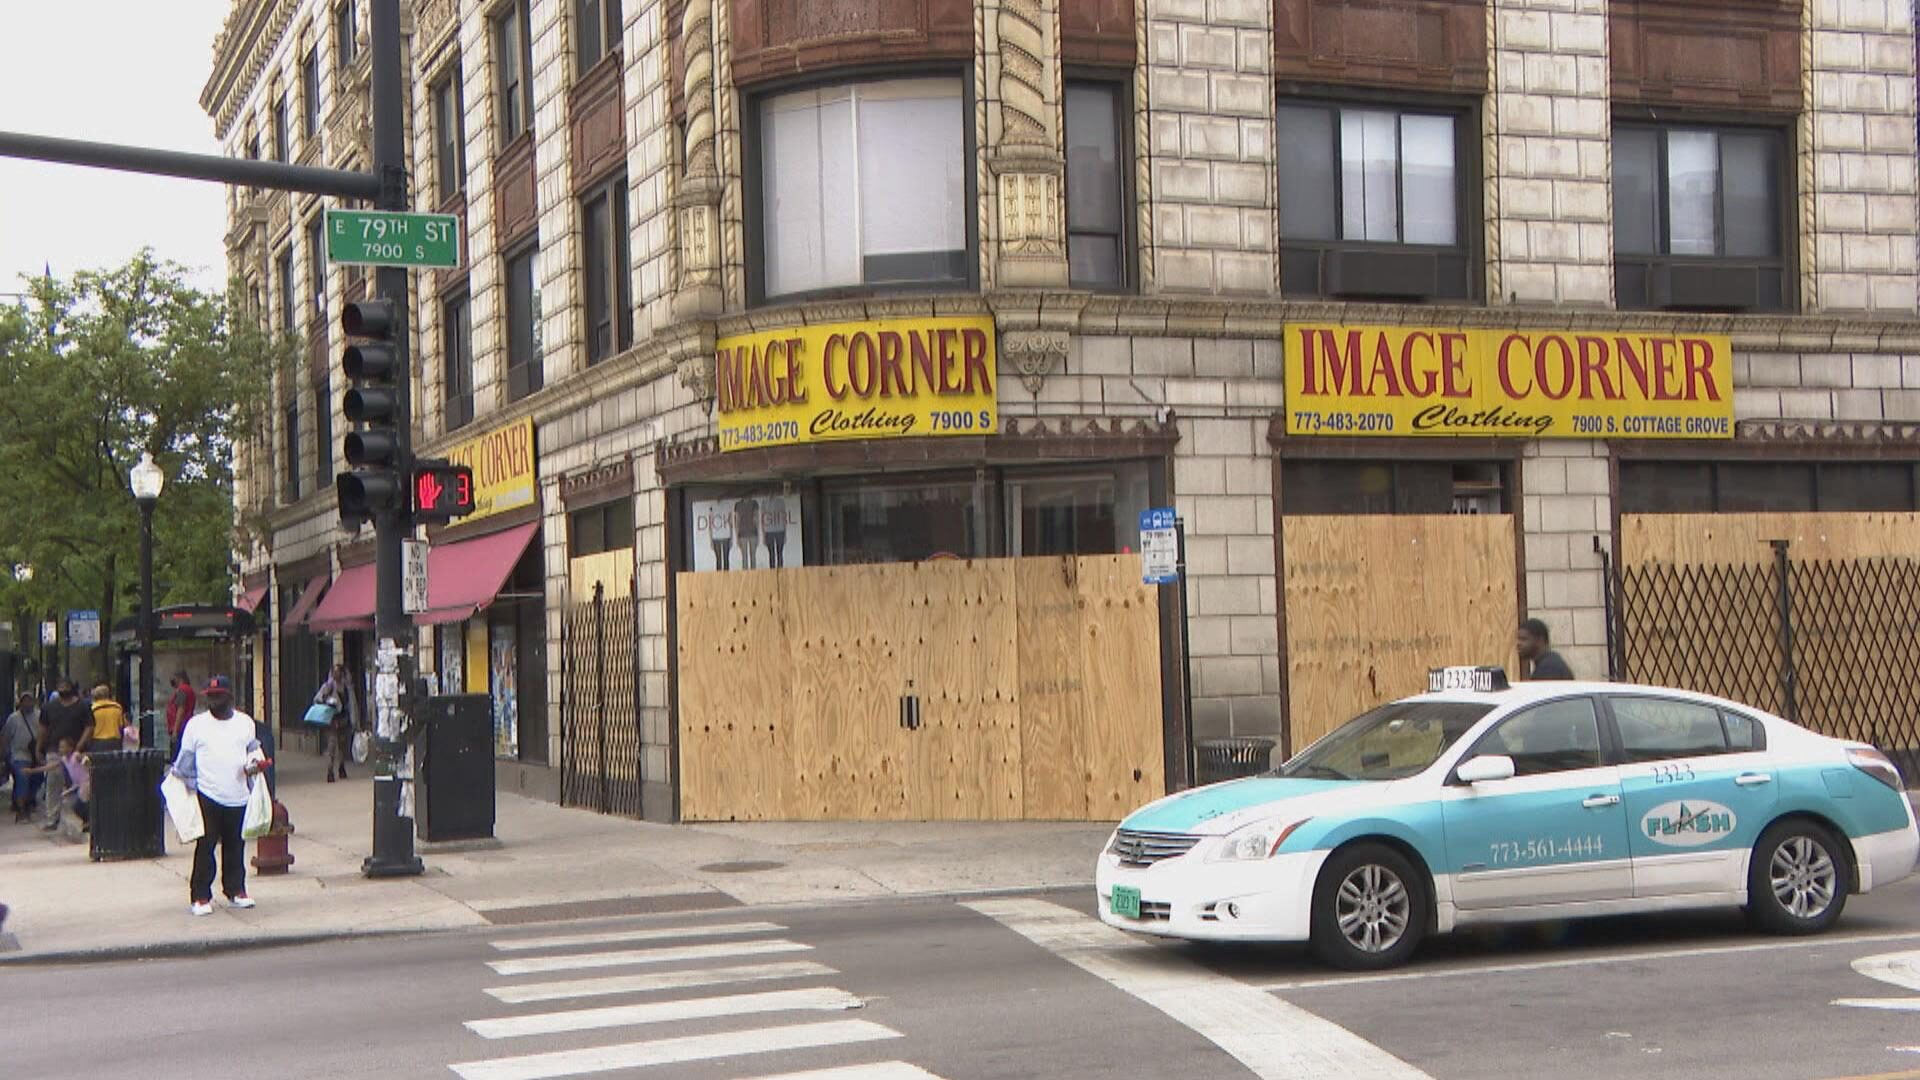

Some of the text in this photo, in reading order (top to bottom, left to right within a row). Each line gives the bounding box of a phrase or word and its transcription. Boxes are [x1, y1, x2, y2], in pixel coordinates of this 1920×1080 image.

[335, 218, 449, 242] E 79TH ST
[362, 243, 425, 259] 7900 S
[715, 328, 993, 413] IMAGE CORNER
[1299, 329, 1721, 401] IMAGE CORNER
[809, 407, 917, 434] Clothing
[931, 411, 991, 429] 7900 S
[1294, 411, 1394, 431] 773-483-2070
[1412, 404, 1554, 435] Clothing
[1572, 415, 1728, 433] 7900 S. COTTAGE GROVE
[721, 421, 799, 447] 773-483-2070
[480, 423, 530, 489] CORNER
[456, 473, 469, 505] 3
[1446, 670, 1474, 689] 2323
[1475, 671, 1492, 691] TAXI
[1651, 764, 1695, 784] 2323
[1647, 801, 1731, 836] FLASH
[1490, 835, 1602, 864] 773-561-4444
